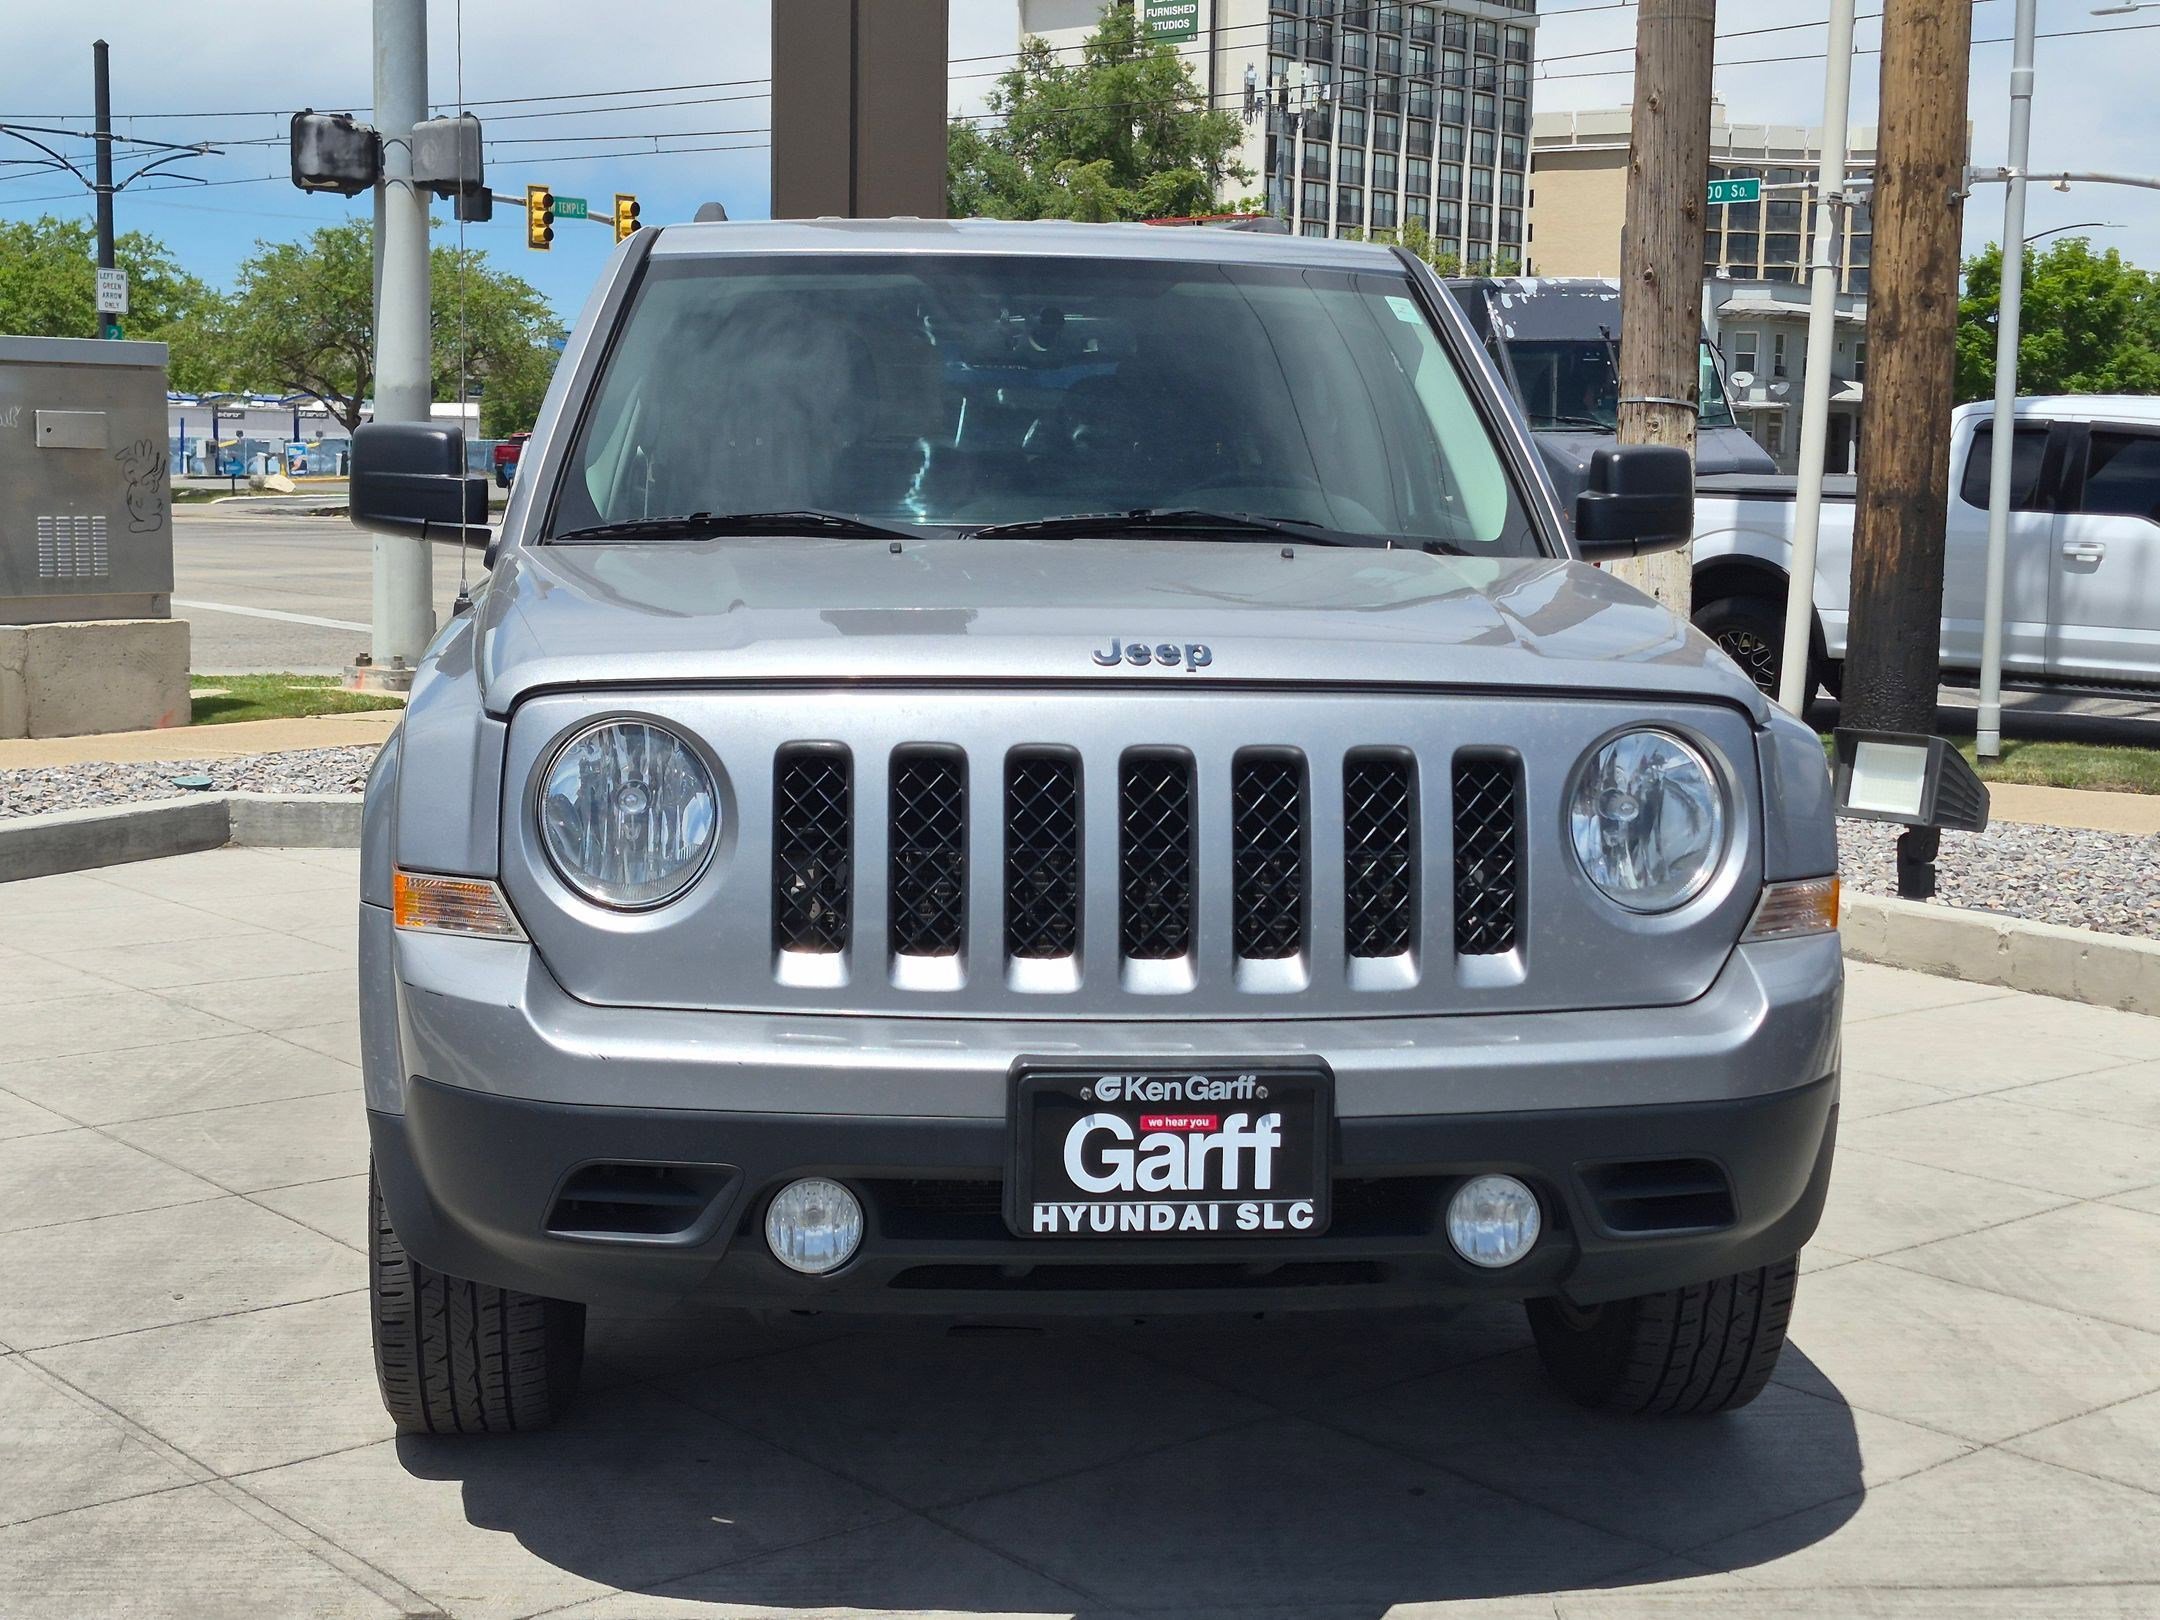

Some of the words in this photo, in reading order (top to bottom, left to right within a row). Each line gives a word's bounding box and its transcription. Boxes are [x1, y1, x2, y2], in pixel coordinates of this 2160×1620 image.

[1146, 4, 1196, 18] FURNISHED
[1152, 18, 1190, 31] STUDIOS
[1731, 184, 1747, 198] So.
[558, 201, 585, 215] TEMPLE
[100, 272, 114, 281] LEFT
[116, 273, 124, 281] ON
[102, 282, 122, 290] GREEN
[102, 291, 122, 300] ARROW
[104, 301, 120, 309] ONLY
[110, 328, 119, 340] 2
[1092, 637, 1213, 673] Jeep
[1125, 1076, 1182, 1101] Ken
[1185, 1075, 1256, 1101] Garff
[1148, 1118, 1163, 1127] we
[1165, 1116, 1188, 1127] hear
[1190, 1118, 1210, 1129] you
[1063, 1113, 1281, 1193] Garff
[1033, 1204, 1218, 1232] HYUNDAI
[1236, 1202, 1314, 1230] SLC
